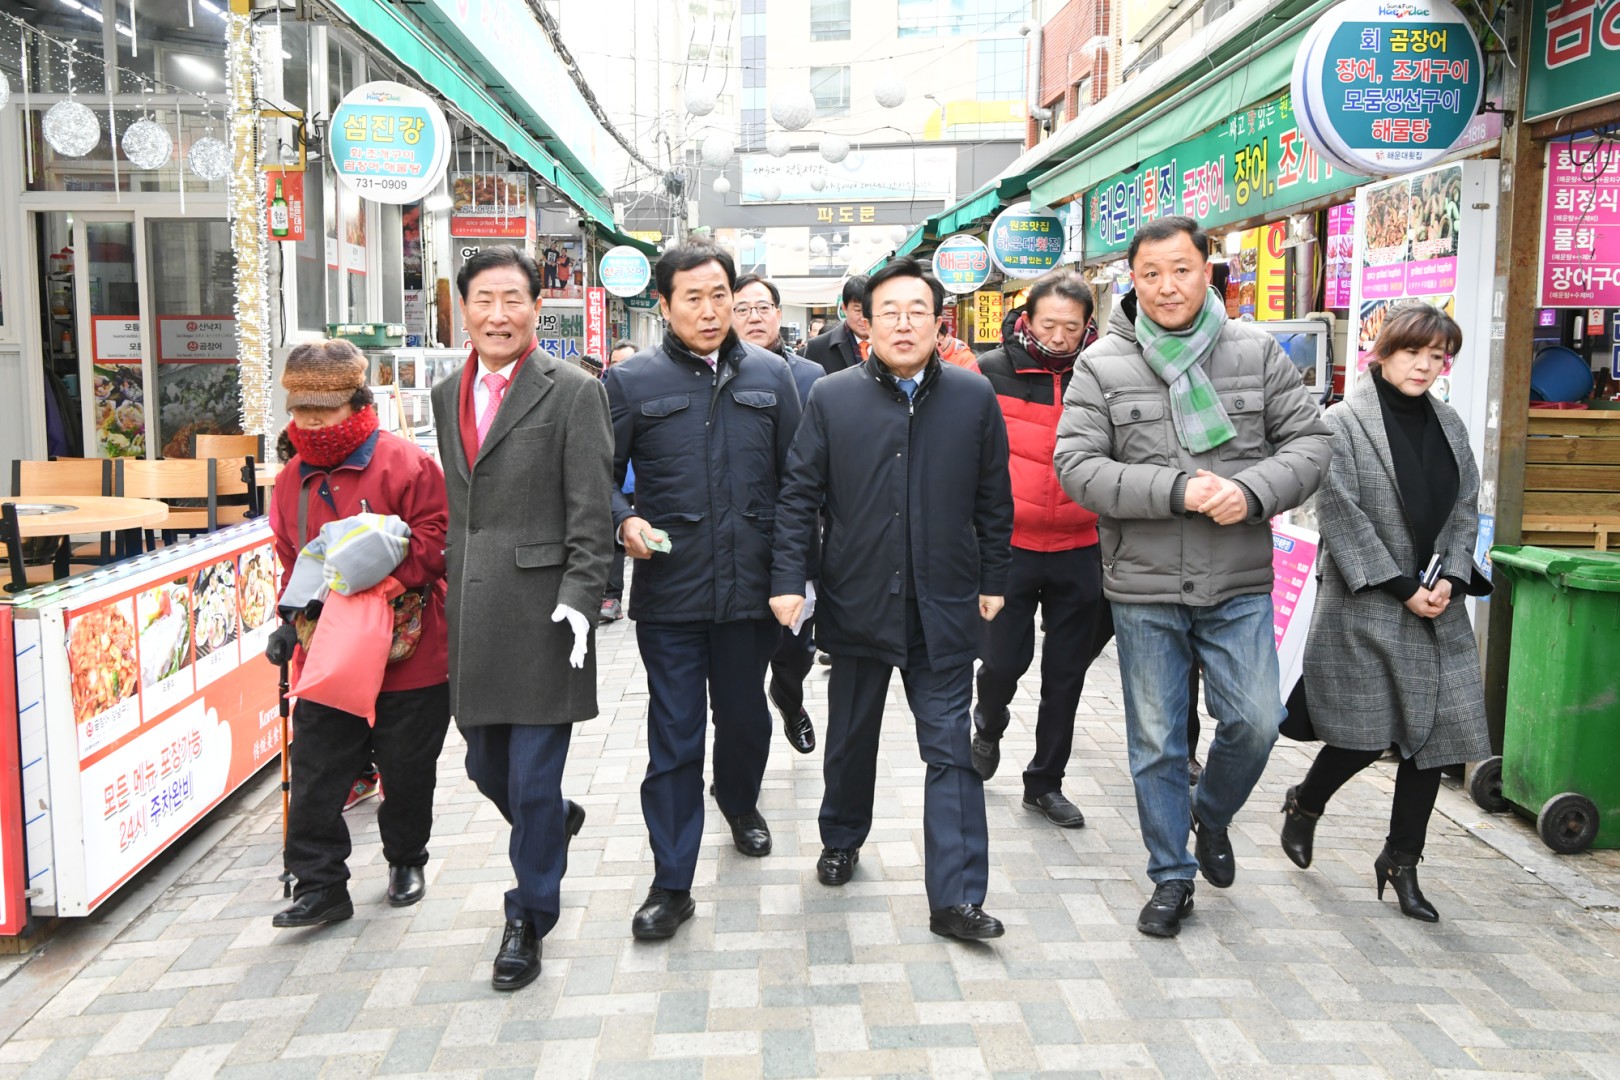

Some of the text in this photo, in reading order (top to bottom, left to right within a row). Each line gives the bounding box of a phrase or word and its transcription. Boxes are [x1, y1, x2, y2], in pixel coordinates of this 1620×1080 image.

[1360, 27, 1448, 54] 회 곰장어
[1335, 58, 1469, 84] 장어, 조개구이
[1343, 88, 1460, 114] 모둠생선구이
[344, 114, 425, 145] 섬진강
[1229, 116, 1246, 144] 싸고
[1247, 103, 1275, 136] 맛있는
[1371, 118, 1431, 143] 해물탕
[1387, 151, 1422, 160] 해운대횟집
[355, 178, 407, 190] 731-0909
[1100, 159, 1176, 246] 해운대횟집
[1554, 188, 1618, 213] 회정식
[817, 206, 876, 223] 파도문
[1009, 220, 1050, 232] 원조맛집
[996, 236, 1061, 252] 해운대횟집
[1552, 227, 1596, 251] 물회
[940, 251, 987, 271] 해금강
[199, 322, 222, 331] 산낙지
[979, 295, 989, 338] 연탄구이
[199, 342, 222, 351] 곰장어
[104, 728, 202, 820] 모든 메뉴 포장가능
[120, 770, 194, 852] 24시 주차완비
